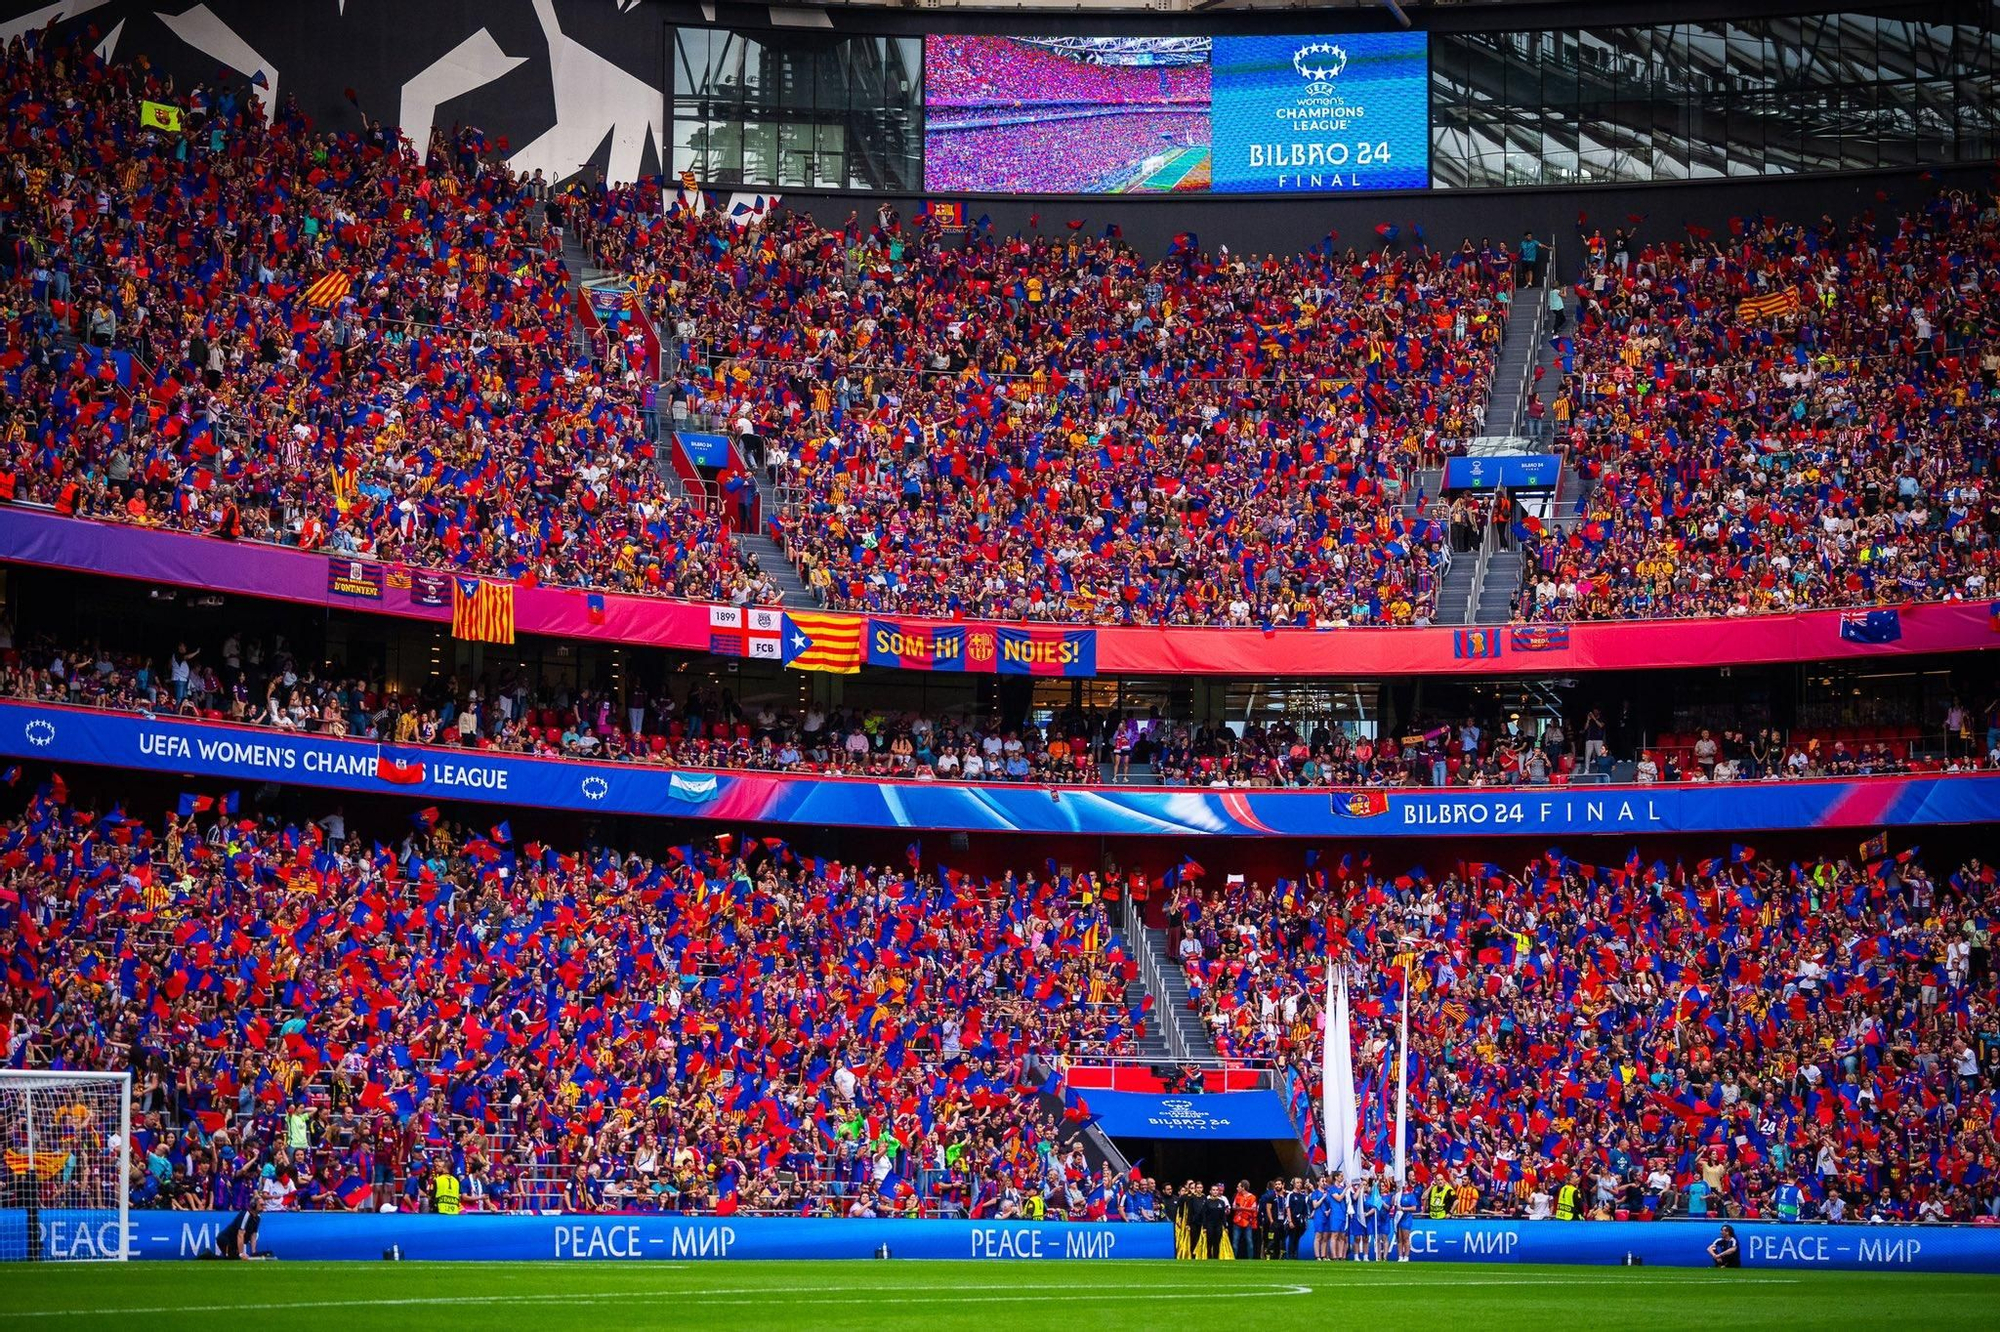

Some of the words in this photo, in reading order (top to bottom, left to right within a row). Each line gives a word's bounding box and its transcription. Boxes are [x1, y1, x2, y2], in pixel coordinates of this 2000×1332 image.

[1304, 83, 1334, 96] UEFA
[1296, 95, 1345, 106] women's
[1275, 106, 1365, 119] CHAMPIONS
[1293, 119, 1348, 131] LEAGUE
[1248, 142, 1349, 167] BILBAO
[1356, 141, 1392, 165] 24
[1278, 172, 1362, 188] FINAL
[715, 611, 736, 622] 1899
[756, 643, 774, 653] FCB
[875, 629, 960, 659] SOM-HI
[1003, 640, 1080, 664] NOIES!
[138, 732, 192, 759] UEFA
[198, 739, 297, 771] WOMEN'S
[433, 763, 508, 791] LEAGUE
[1403, 803, 1488, 825] BILBAO
[1494, 803, 1525, 824] 24
[1540, 800, 1661, 823] FINAL
[1760, 1118, 1777, 1133] 24
[555, 1225, 642, 1257] PEACE
[971, 1228, 1042, 1258] PEACE
[1748, 1235, 1830, 1261] PEACE
